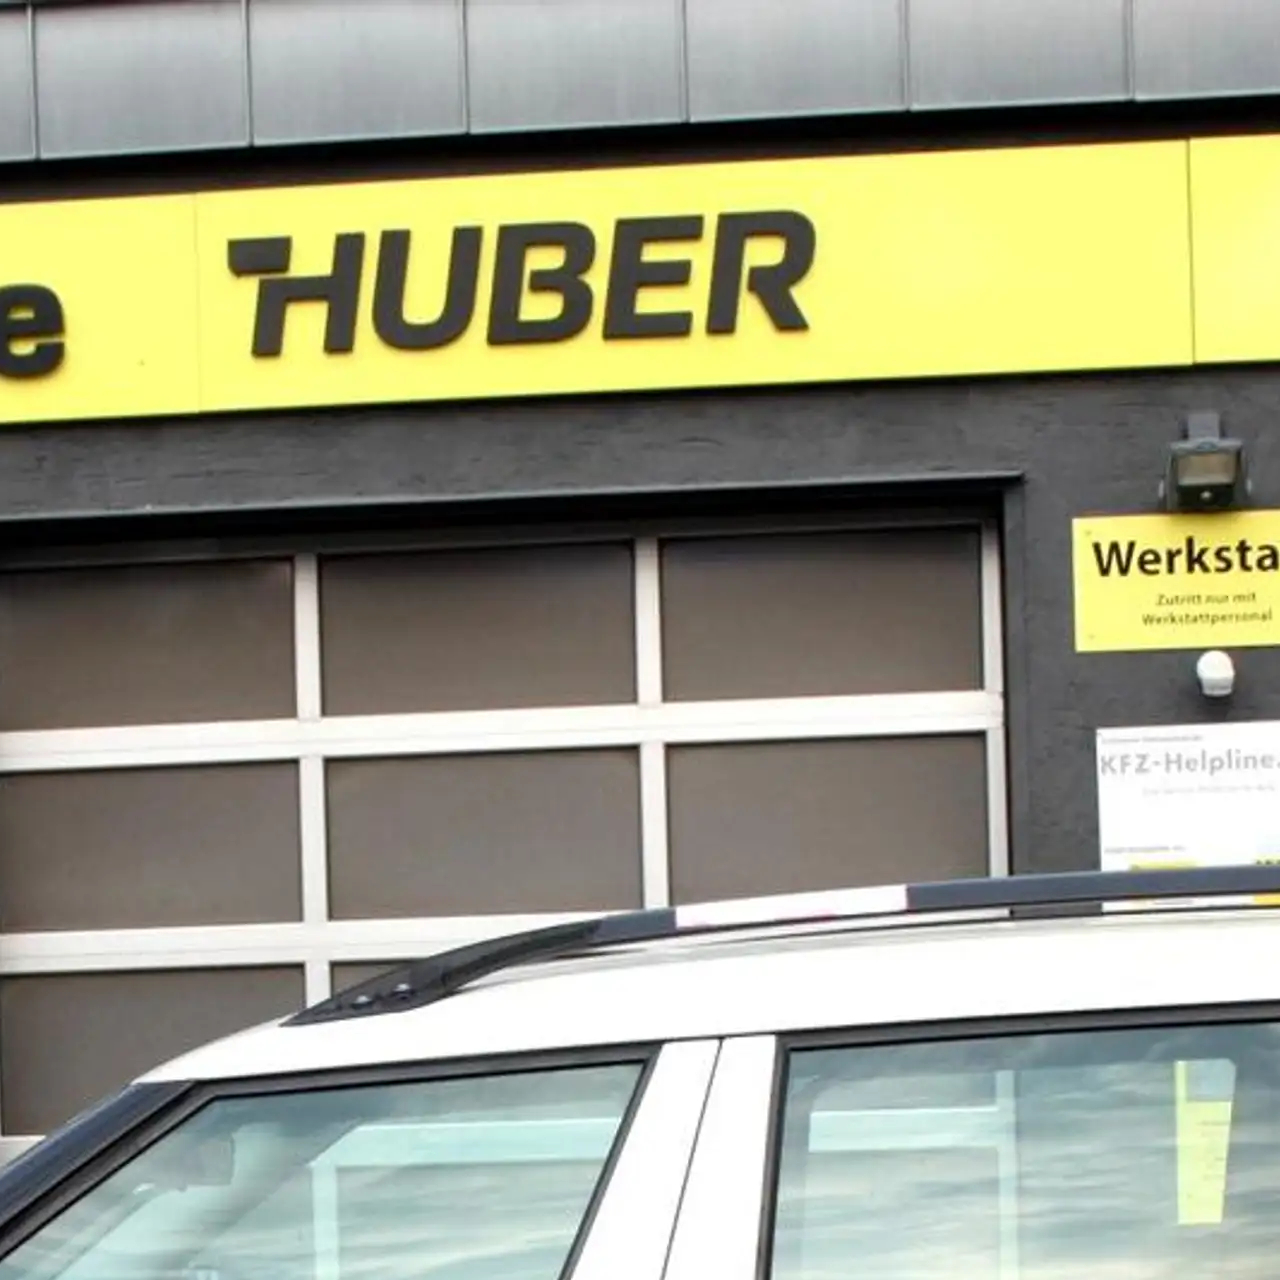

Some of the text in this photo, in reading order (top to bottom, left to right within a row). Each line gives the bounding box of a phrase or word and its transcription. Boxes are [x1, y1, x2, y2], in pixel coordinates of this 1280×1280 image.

[227, 209, 817, 359] HUBER
[1155, 592, 1256, 606] Zutritt nur mit
[1142, 608, 1273, 626] Werkstattpersonal
